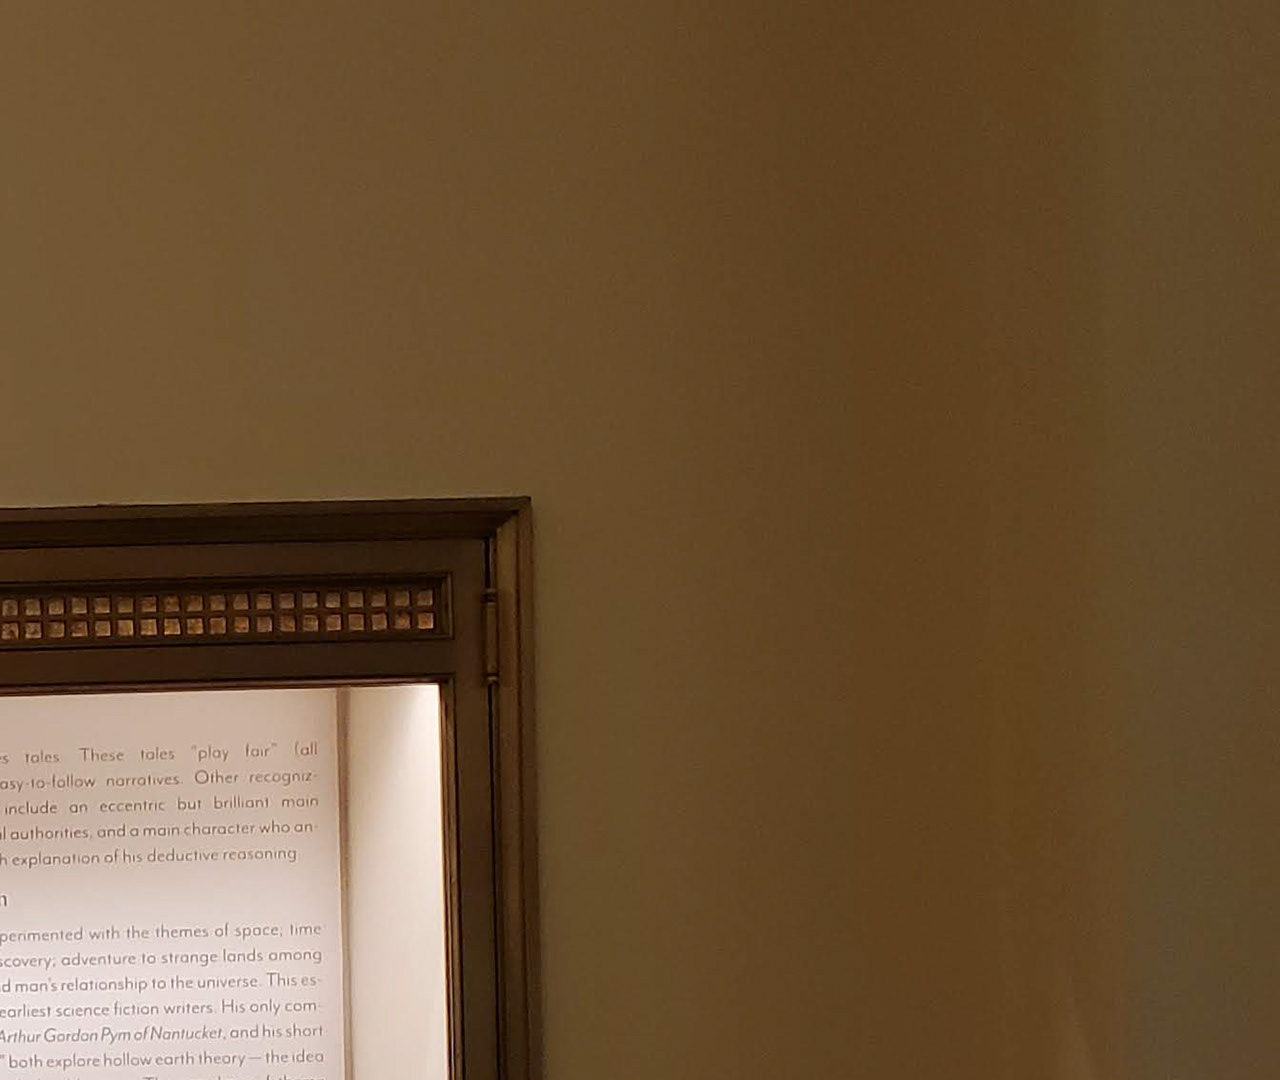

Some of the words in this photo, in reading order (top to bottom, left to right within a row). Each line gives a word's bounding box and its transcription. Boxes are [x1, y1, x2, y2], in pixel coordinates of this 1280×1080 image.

[78, 747, 126, 762] These
[293, 741, 320, 760] (all
[88, 925, 122, 940] with
[126, 925, 151, 939] the
[154, 924, 210, 938] themes
[213, 922, 230, 937] of
[289, 924, 323, 937] time
